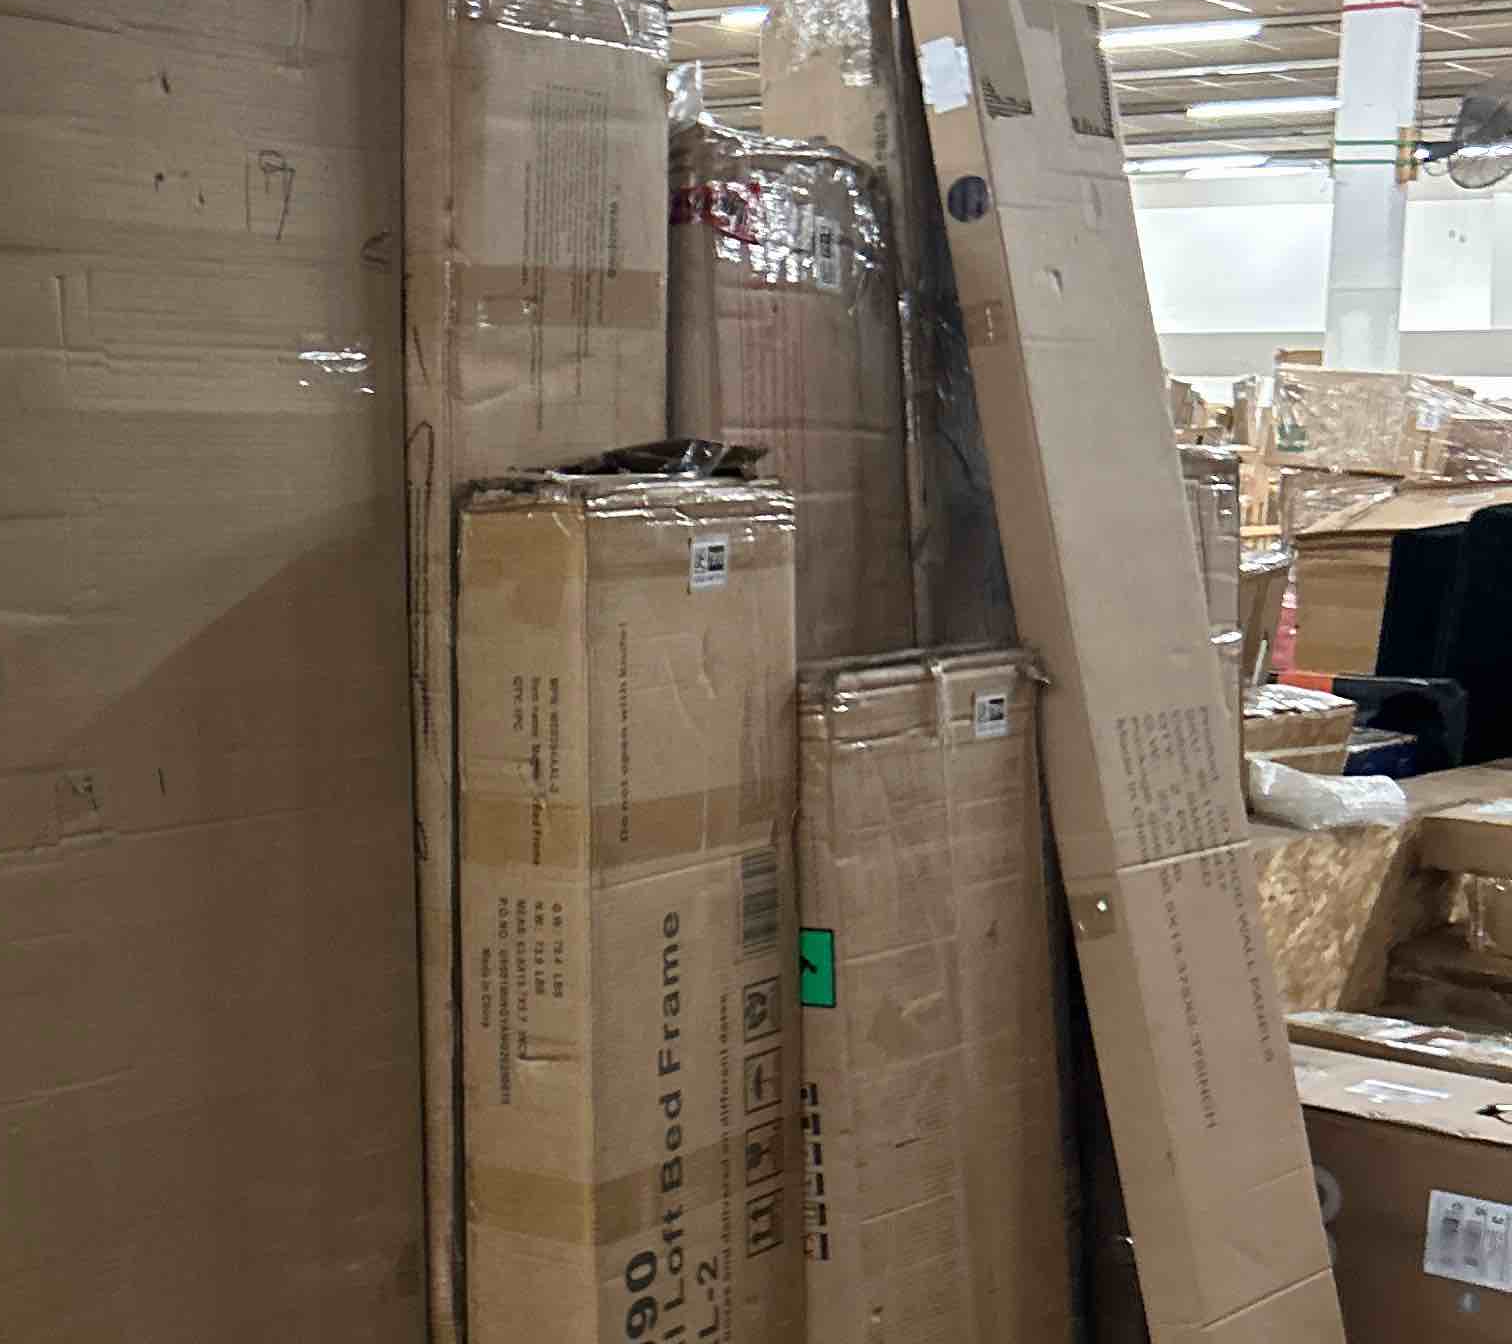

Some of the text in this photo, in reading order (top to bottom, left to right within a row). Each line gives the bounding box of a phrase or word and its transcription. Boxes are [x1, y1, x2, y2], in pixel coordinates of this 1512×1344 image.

[658, 910, 682, 1078] Frame
[660, 1088, 684, 1194] Bed
[662, 1203, 686, 1312] Loft
